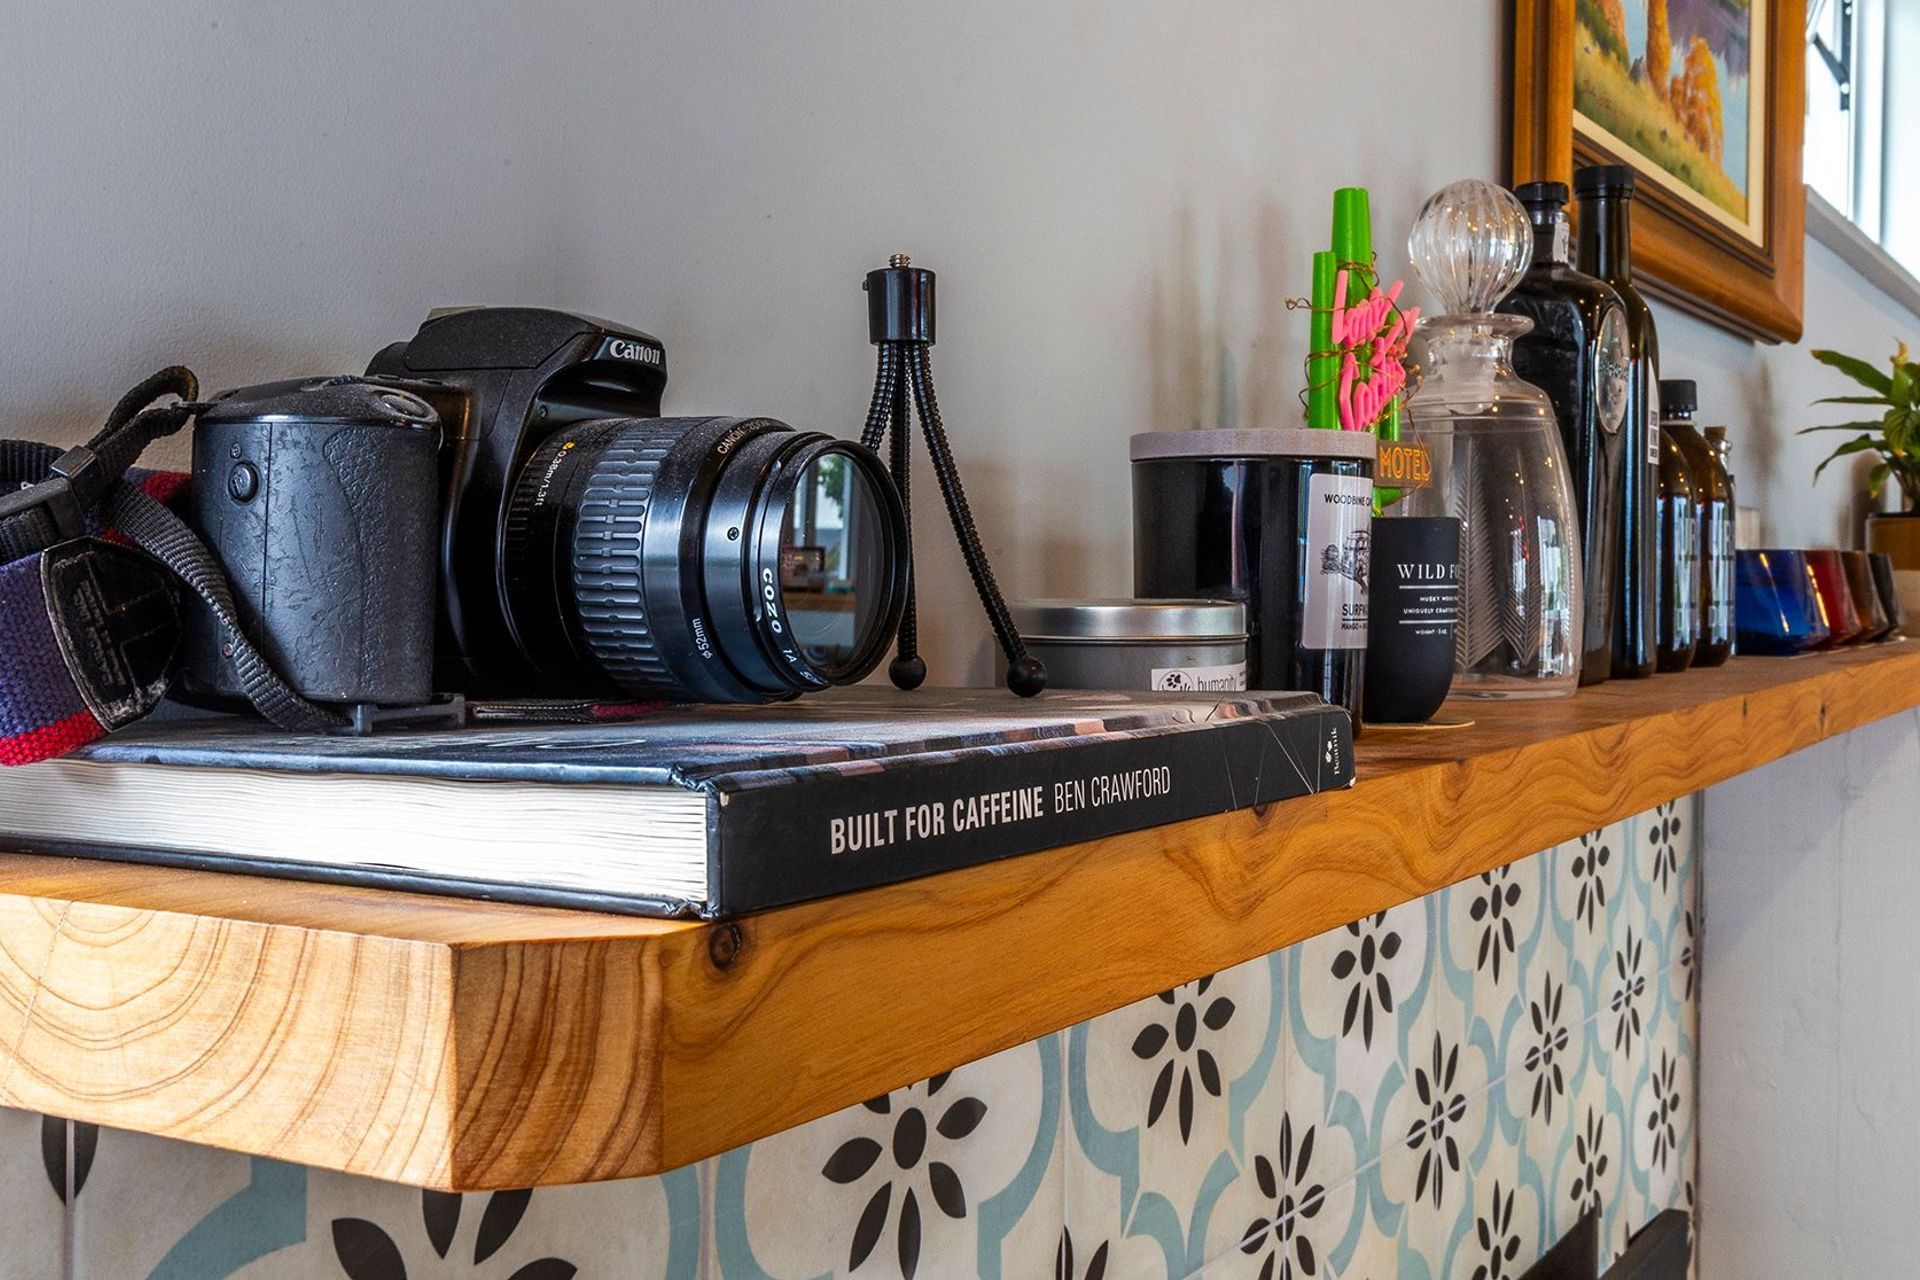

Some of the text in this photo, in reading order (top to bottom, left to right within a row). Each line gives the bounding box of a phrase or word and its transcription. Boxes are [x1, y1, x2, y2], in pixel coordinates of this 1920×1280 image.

[610, 340, 660, 364] Canon
[717, 427, 744, 454] CANON
[1380, 446, 1430, 481] MOTEL
[1324, 493, 1365, 506] WOODBINE
[1397, 564, 1445, 579] WILD
[831, 766, 1171, 854] BUILT FOR CAFFEINE BEN CRAWFORD
